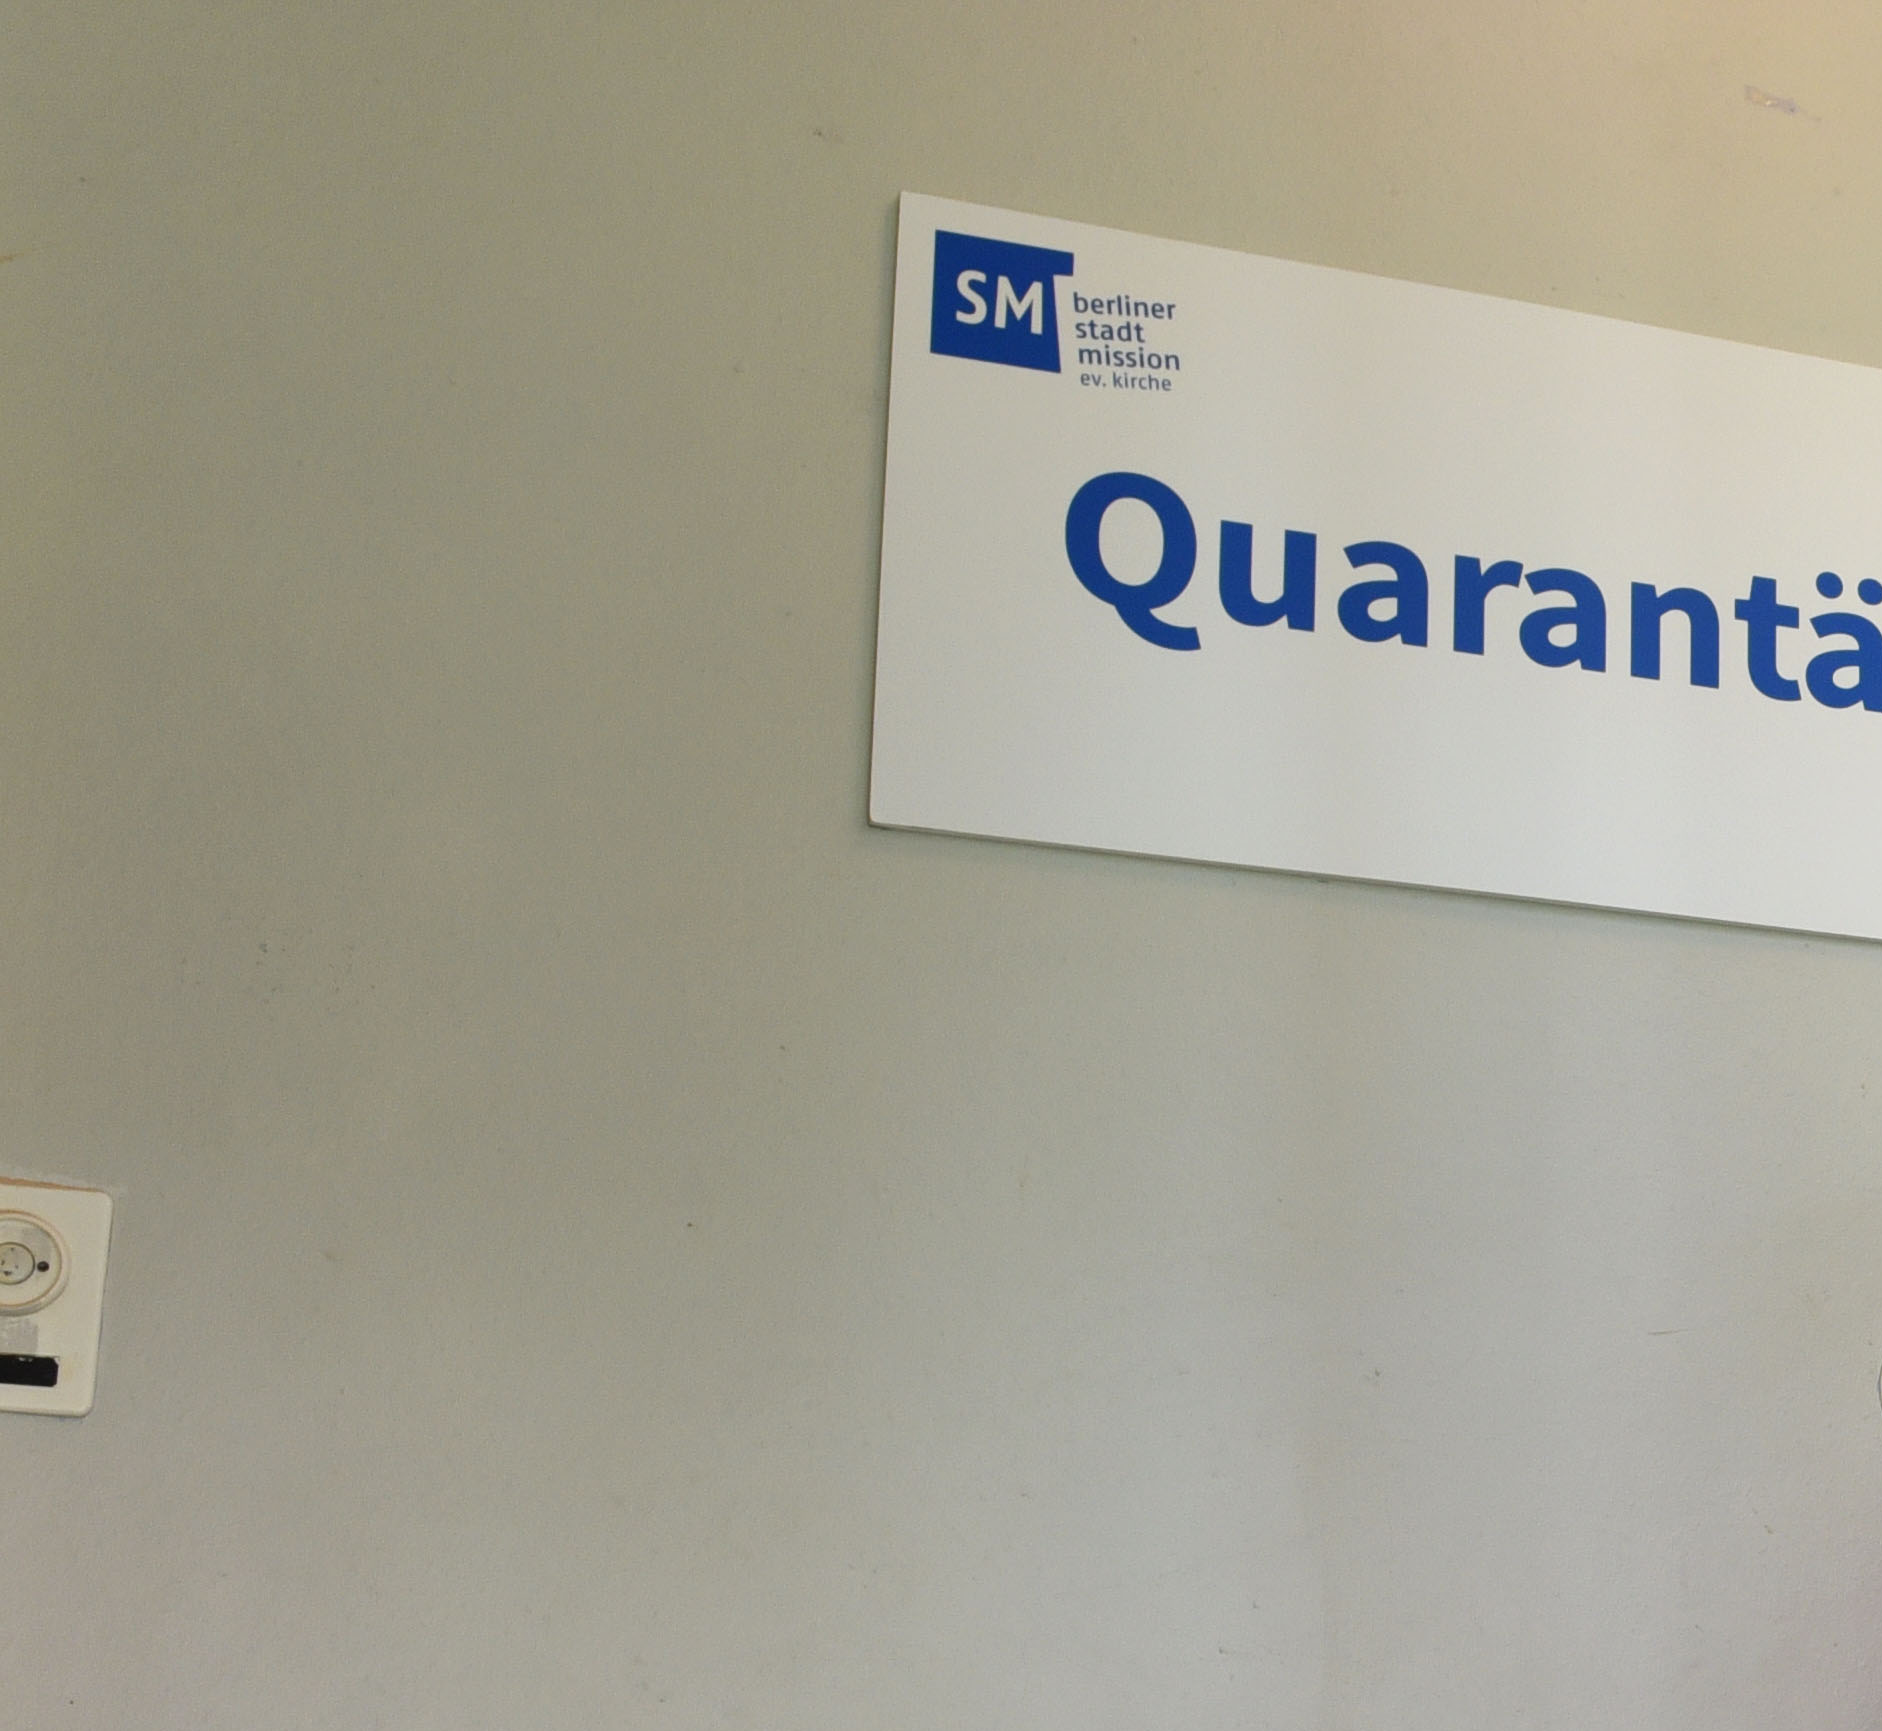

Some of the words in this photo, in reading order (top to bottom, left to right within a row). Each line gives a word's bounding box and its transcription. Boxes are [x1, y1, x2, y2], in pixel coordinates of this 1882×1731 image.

[955, 269, 1044, 336] SM
[1073, 291, 1177, 320] berliner
[1075, 319, 1146, 344] stadt
[1078, 344, 1181, 371] mission
[1080, 374, 1107, 388] ev.
[1112, 372, 1172, 392] kirche
